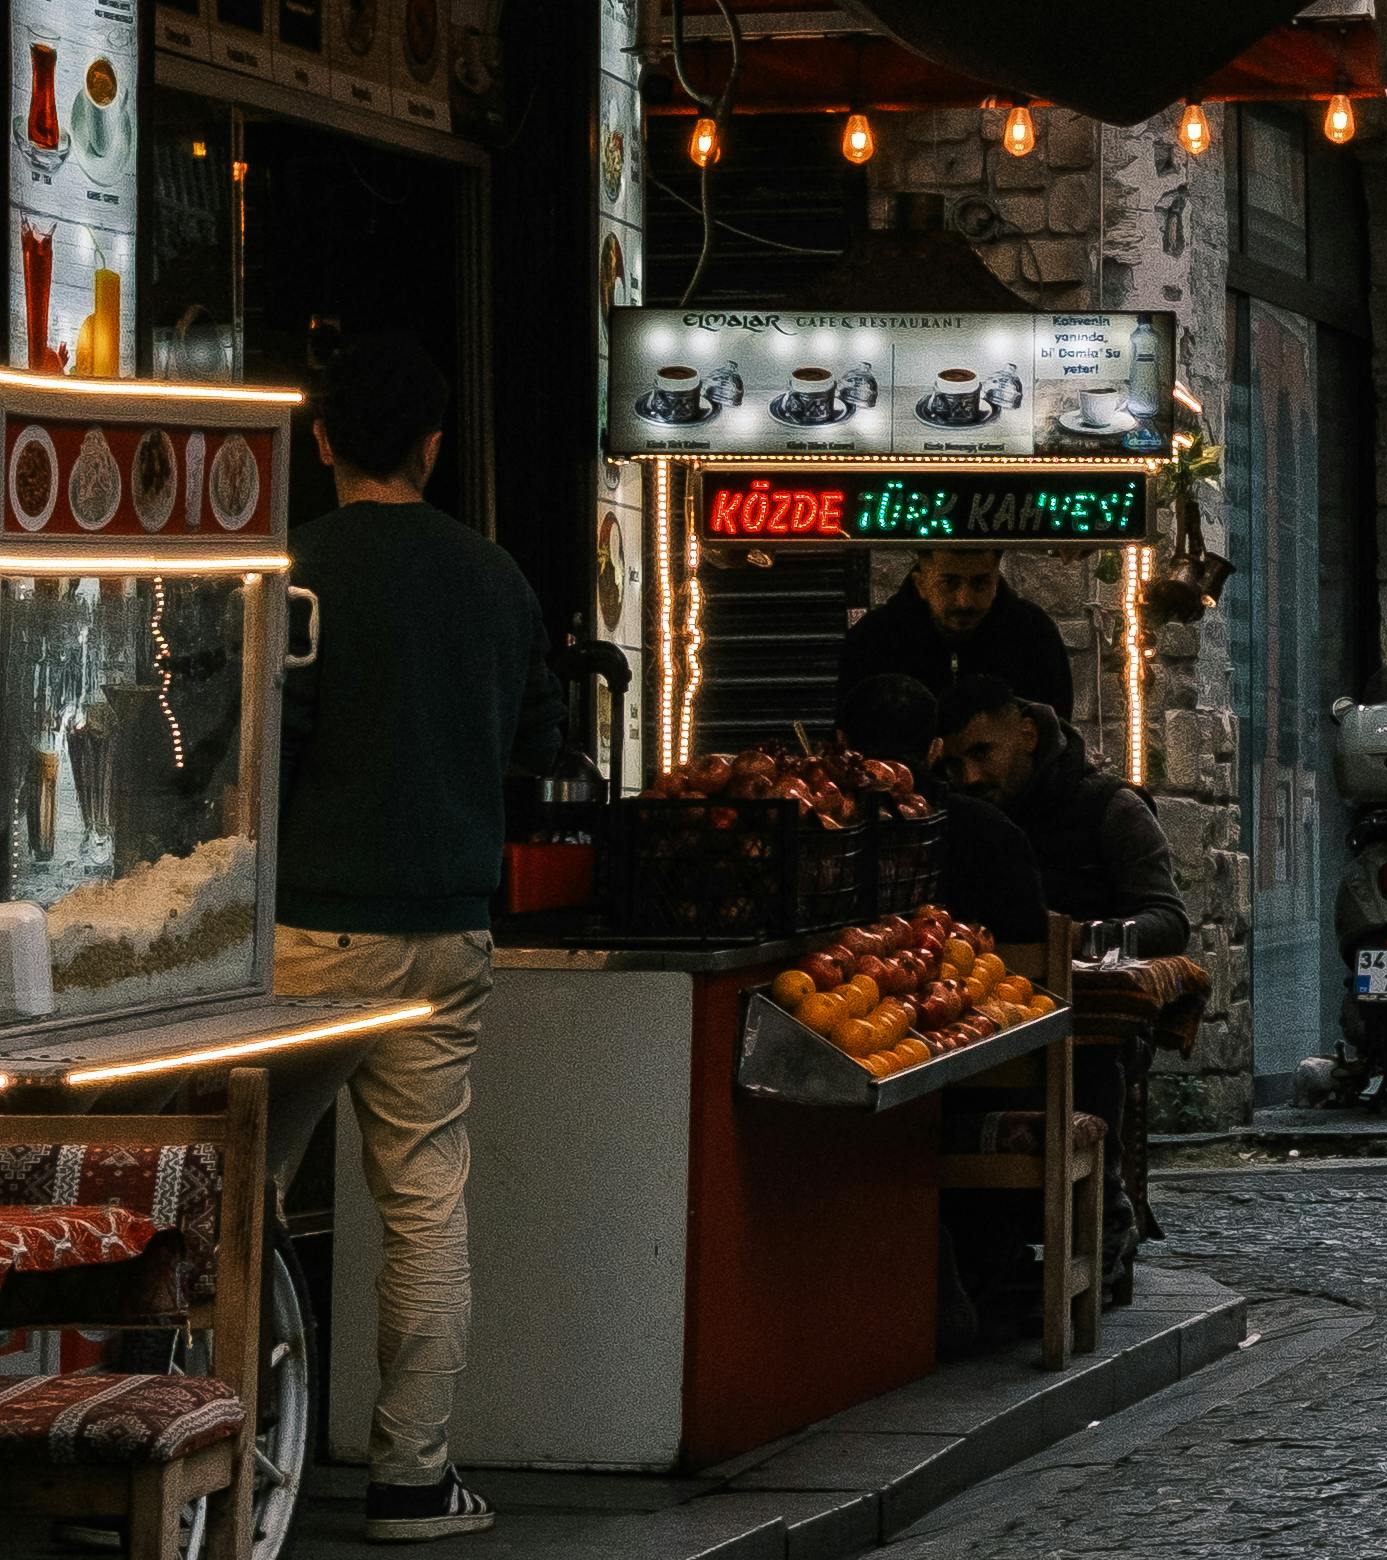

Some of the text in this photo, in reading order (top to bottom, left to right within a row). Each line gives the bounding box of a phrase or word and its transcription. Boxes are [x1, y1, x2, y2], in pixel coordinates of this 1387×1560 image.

[711, 480, 844, 534] KÖZDE
[858, 479, 958, 536] TÜRK
[1360, 952, 1386, 970] 34
